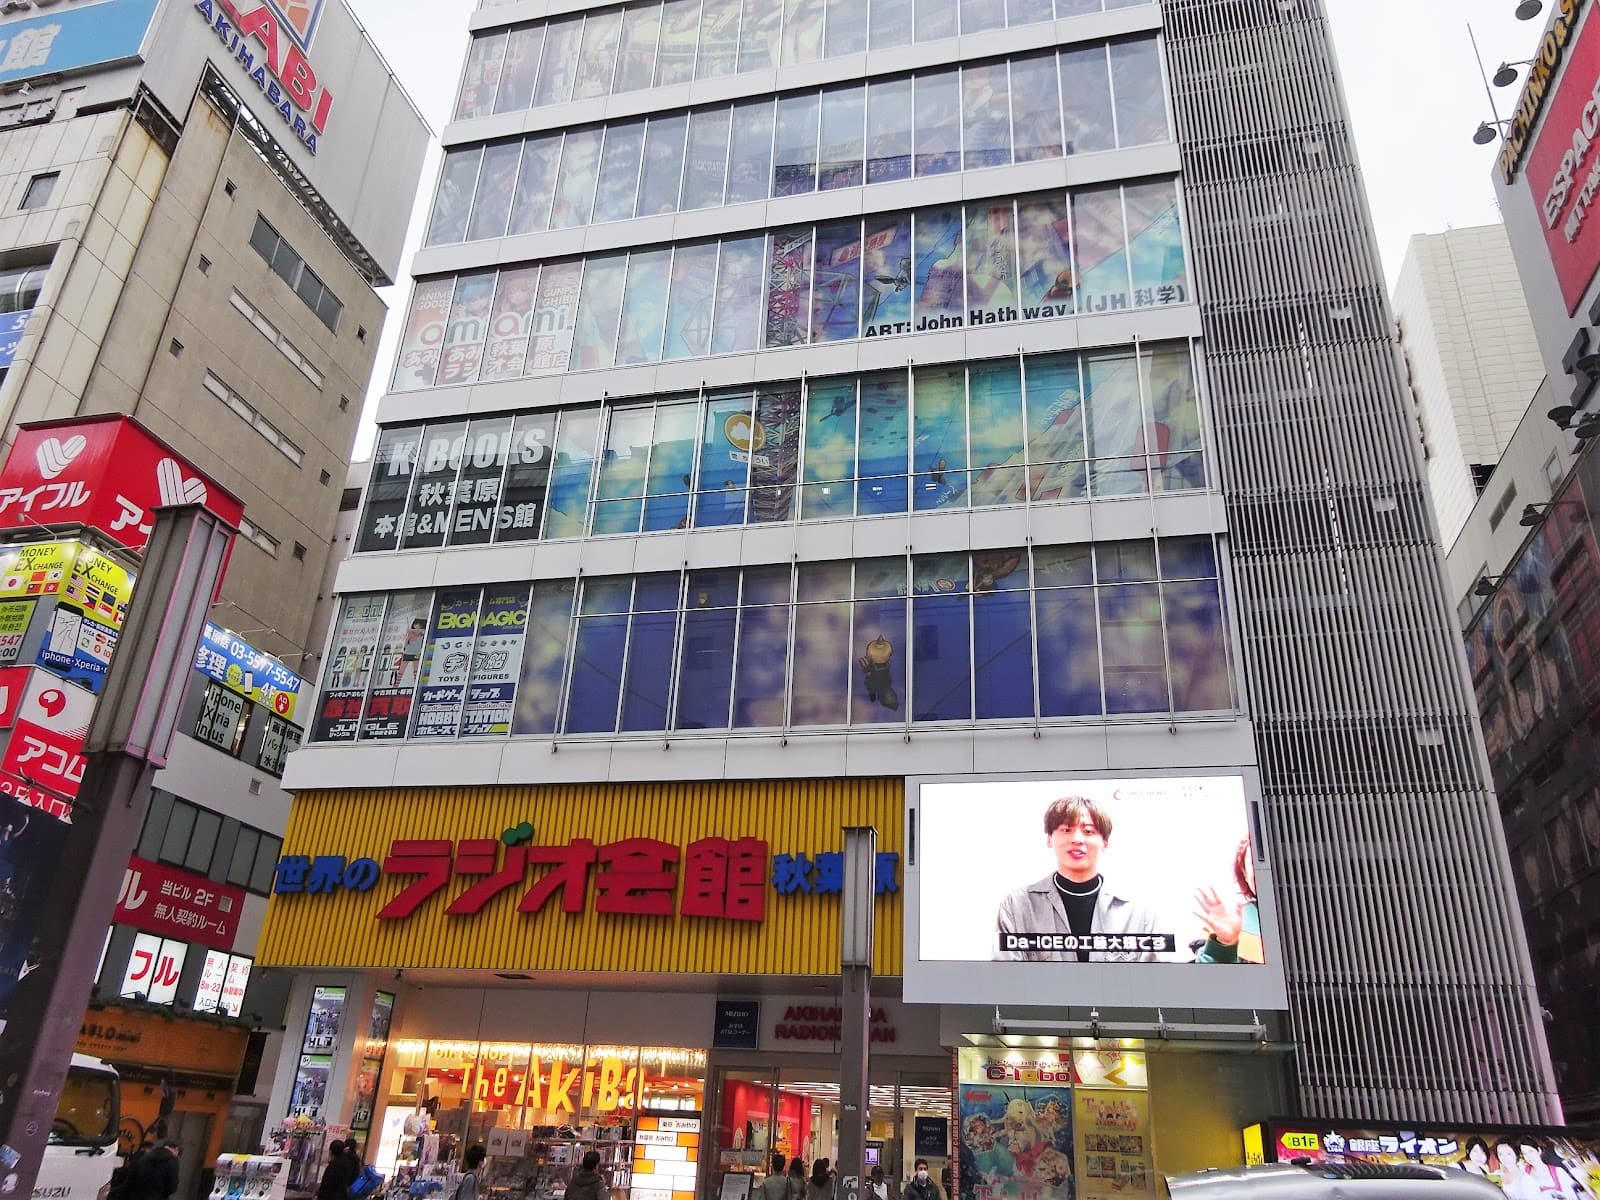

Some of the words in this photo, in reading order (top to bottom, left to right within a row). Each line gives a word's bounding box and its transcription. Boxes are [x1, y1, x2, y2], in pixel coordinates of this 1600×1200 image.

[197, 0, 317, 156] AKIHABARA
[1501, 31, 1559, 185] PACHINKO
[865, 321, 911, 338] ART:
[917, 316, 963, 332] John
[0, 481, 91, 513] アイフル
[419, 478, 501, 507] 秋葉原
[14, 557, 64, 572] EXCHANGE
[19, 547, 56, 558] MONEY
[17, 735, 87, 784] アコム
[274, 855, 380, 894] 世界の
[374, 822, 768, 922] ラジオ会館
[160, 879, 191, 900] 当ビル
[194, 888, 215, 906] 2F
[154, 902, 226, 936] 無人契約ルーム
[784, 1006, 888, 1023] AKIHAA
[774, 1024, 896, 1042] RADIOKAN
[459, 1062, 508, 1098] The
[1292, 1135, 1316, 1147] B1F
